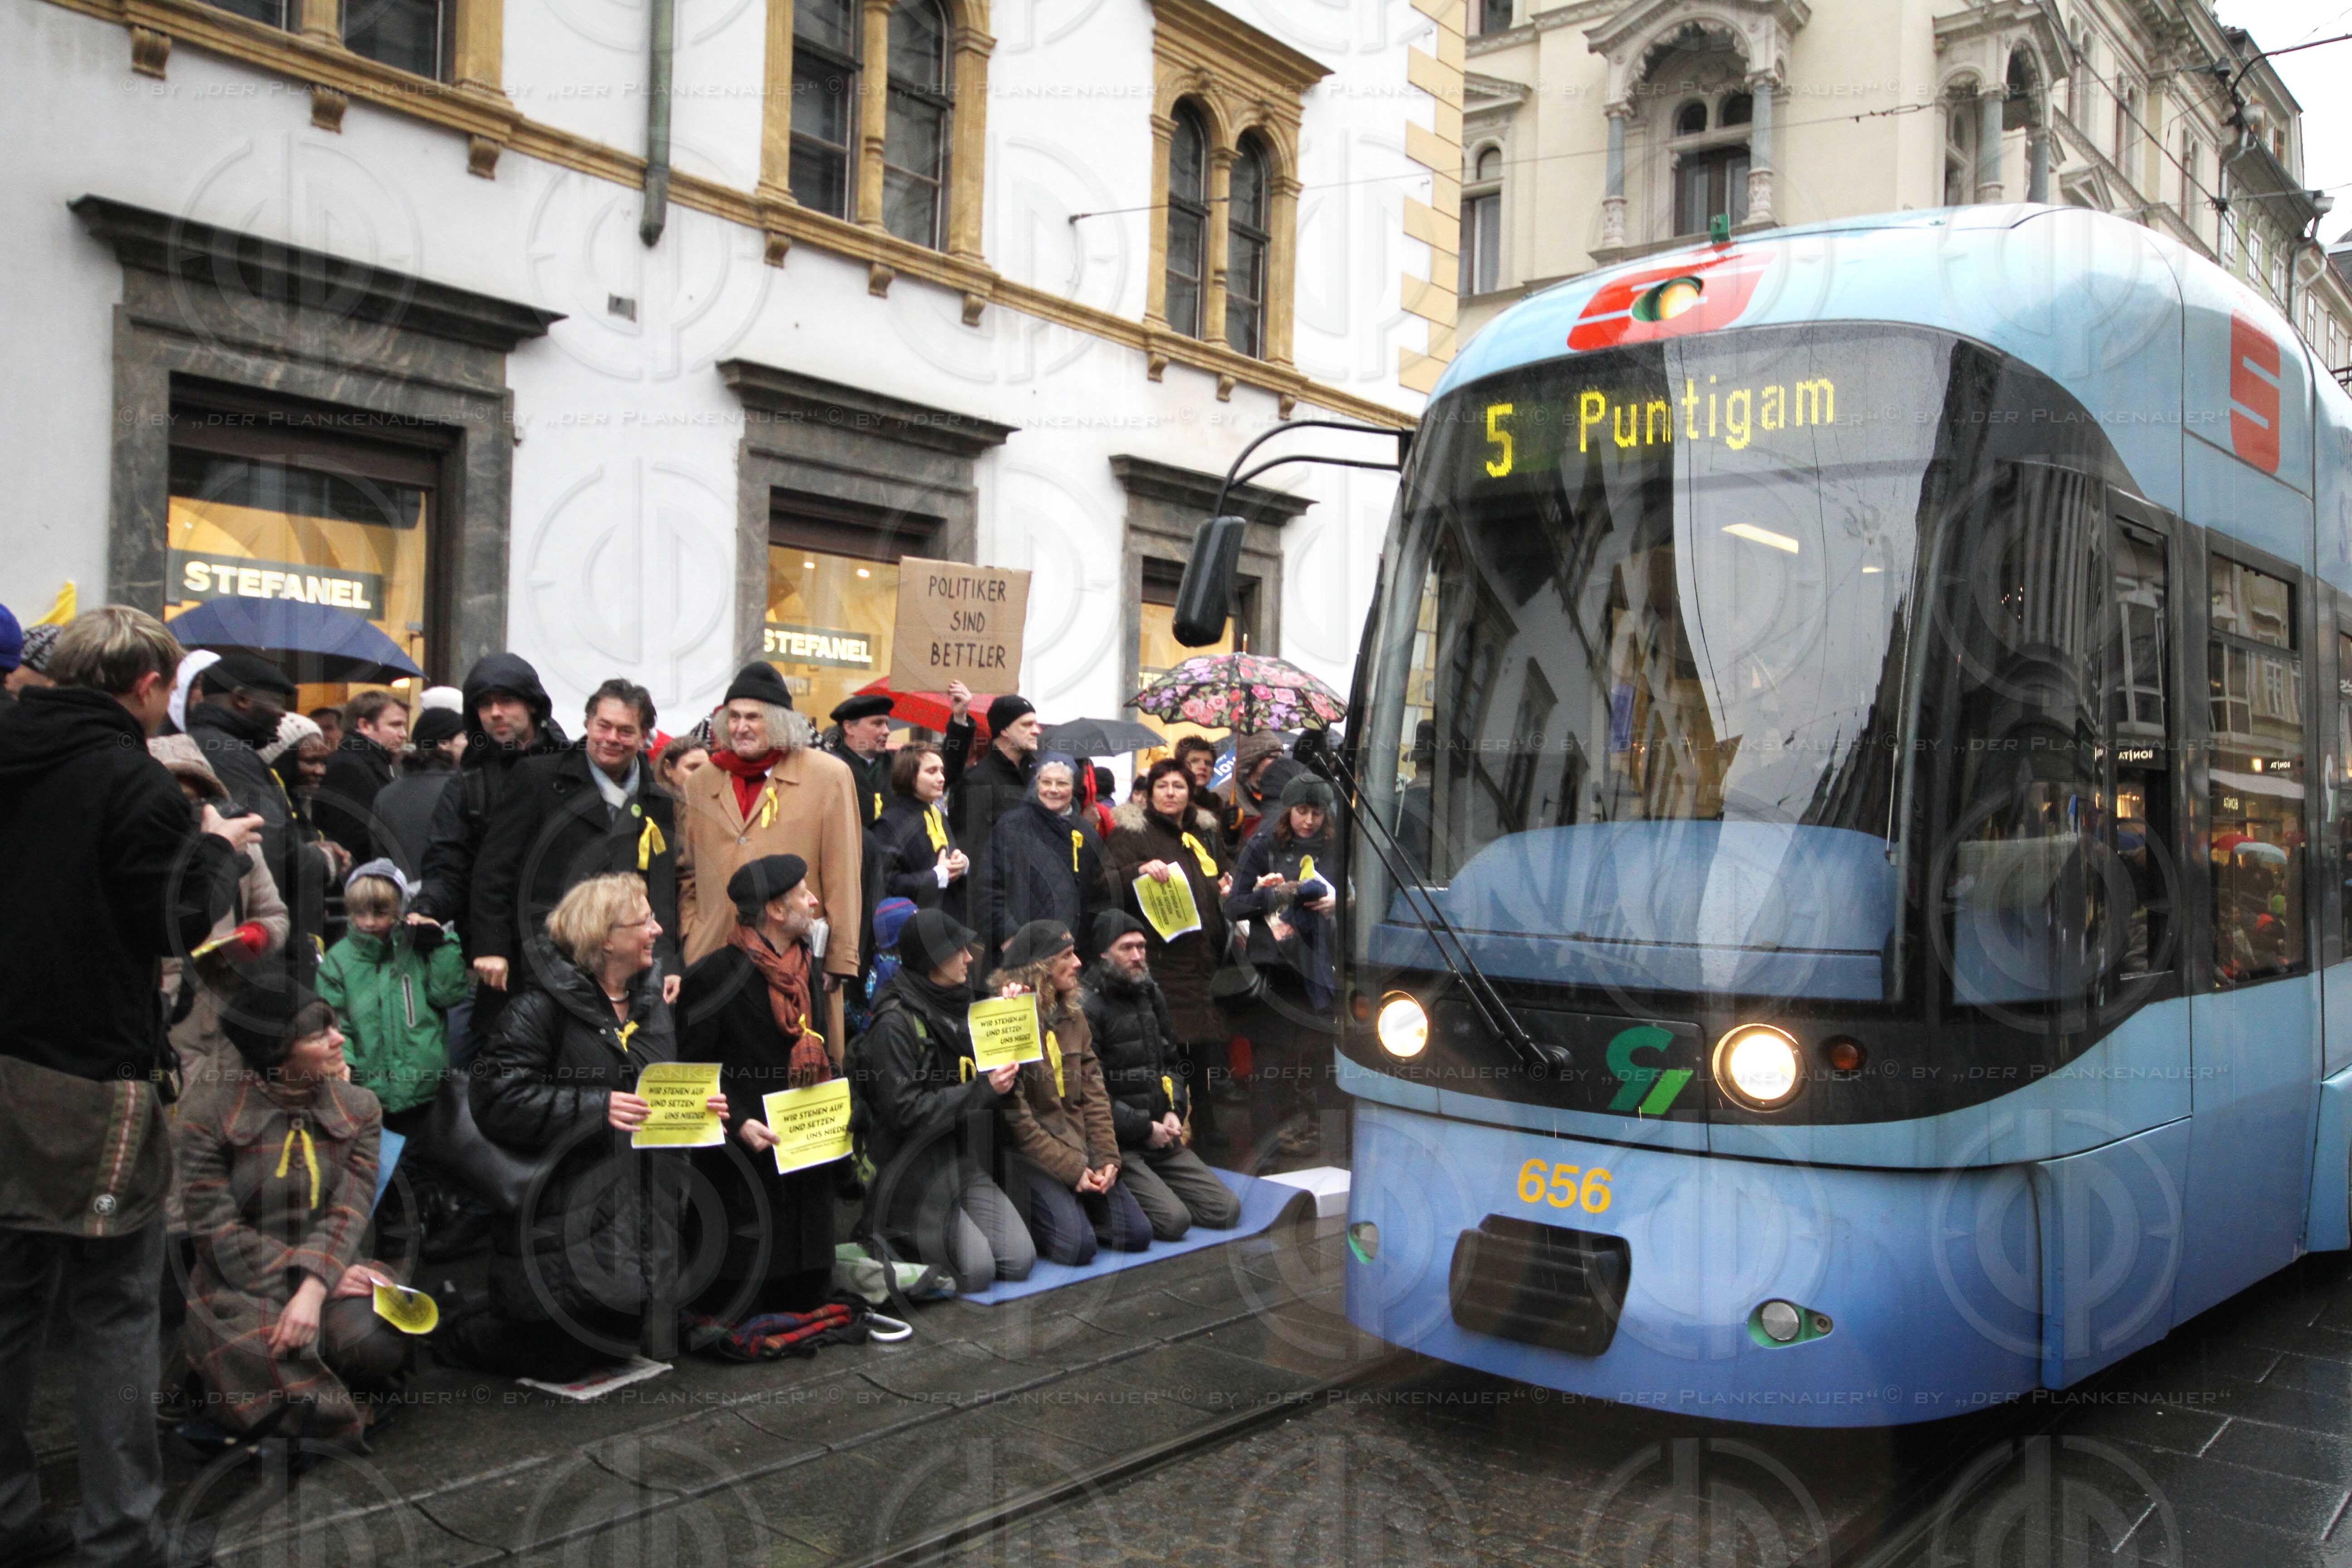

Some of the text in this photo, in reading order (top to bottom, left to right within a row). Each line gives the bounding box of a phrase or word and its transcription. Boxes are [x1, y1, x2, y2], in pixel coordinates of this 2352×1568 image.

[1486, 375, 1834, 478] 5 Puntigam
[184, 561, 371, 609] STEFANEL
[929, 576, 1006, 602] POLITIKER
[950, 611, 985, 633] SIND
[764, 628, 872, 663] STEFANEL
[931, 642, 1005, 669] BETTLER
[1517, 1158, 1613, 1214] 656
